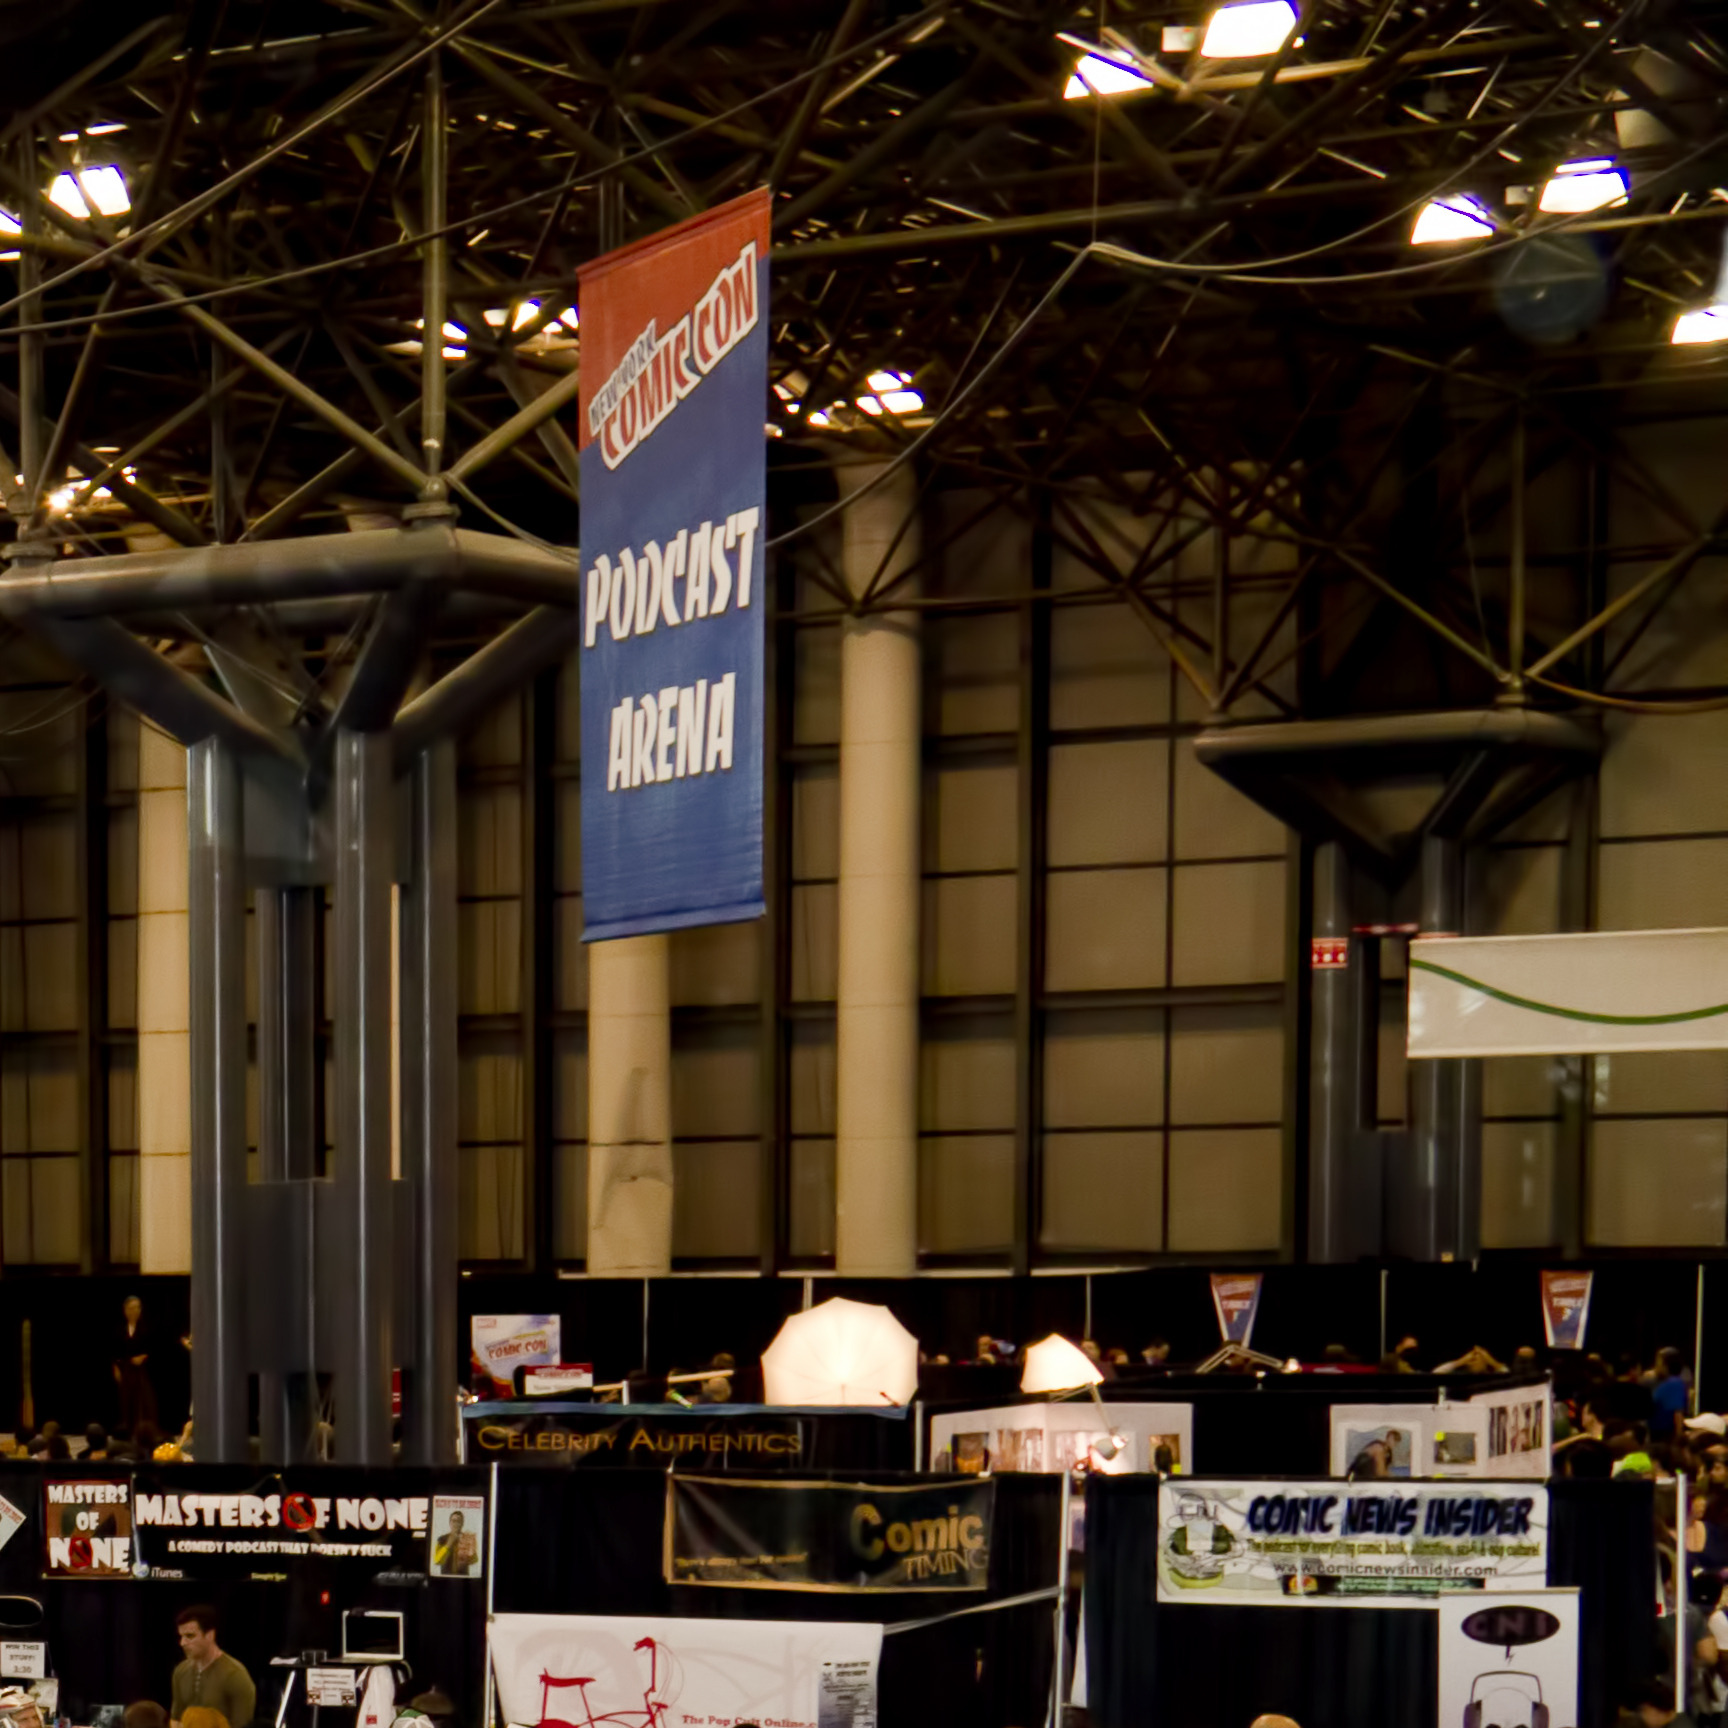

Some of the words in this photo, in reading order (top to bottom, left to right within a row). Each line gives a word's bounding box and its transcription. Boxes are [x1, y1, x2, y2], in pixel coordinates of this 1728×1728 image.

[602, 316, 696, 466] COMIC
[693, 244, 757, 374] CON
[585, 506, 759, 648] PODCAST
[608, 672, 736, 793] ARENA
[48, 1484, 128, 1504] MASTERS
[75, 1511, 100, 1531] OF
[135, 1493, 281, 1528] MASTERS
[336, 1497, 429, 1531] NONE
[1246, 1495, 1338, 1536] COMIC
[1339, 1494, 1419, 1537] NEWS
[1423, 1494, 1535, 1537] INSIDER
[168, 1540, 177, 1552] A
[177, 1540, 224, 1553] COMEDY
[225, 1541, 279, 1554] PODCAST
[278, 1542, 310, 1555] THAT
[360, 1545, 393, 1557] SUCK
[849, 1503, 984, 1562] Comic
[49, 1536, 131, 1569] NONE
[902, 1548, 990, 1581] TIMING
[151, 1566, 184, 1579] iTunes
[1274, 1562, 1498, 1577] www.comicnewsinsider.com
[1466, 1612, 1547, 1638] CNI
[682, 1714, 704, 1725] The
[708, 1715, 731, 1728] Pop
[764, 1717, 817, 1728] Online.c
